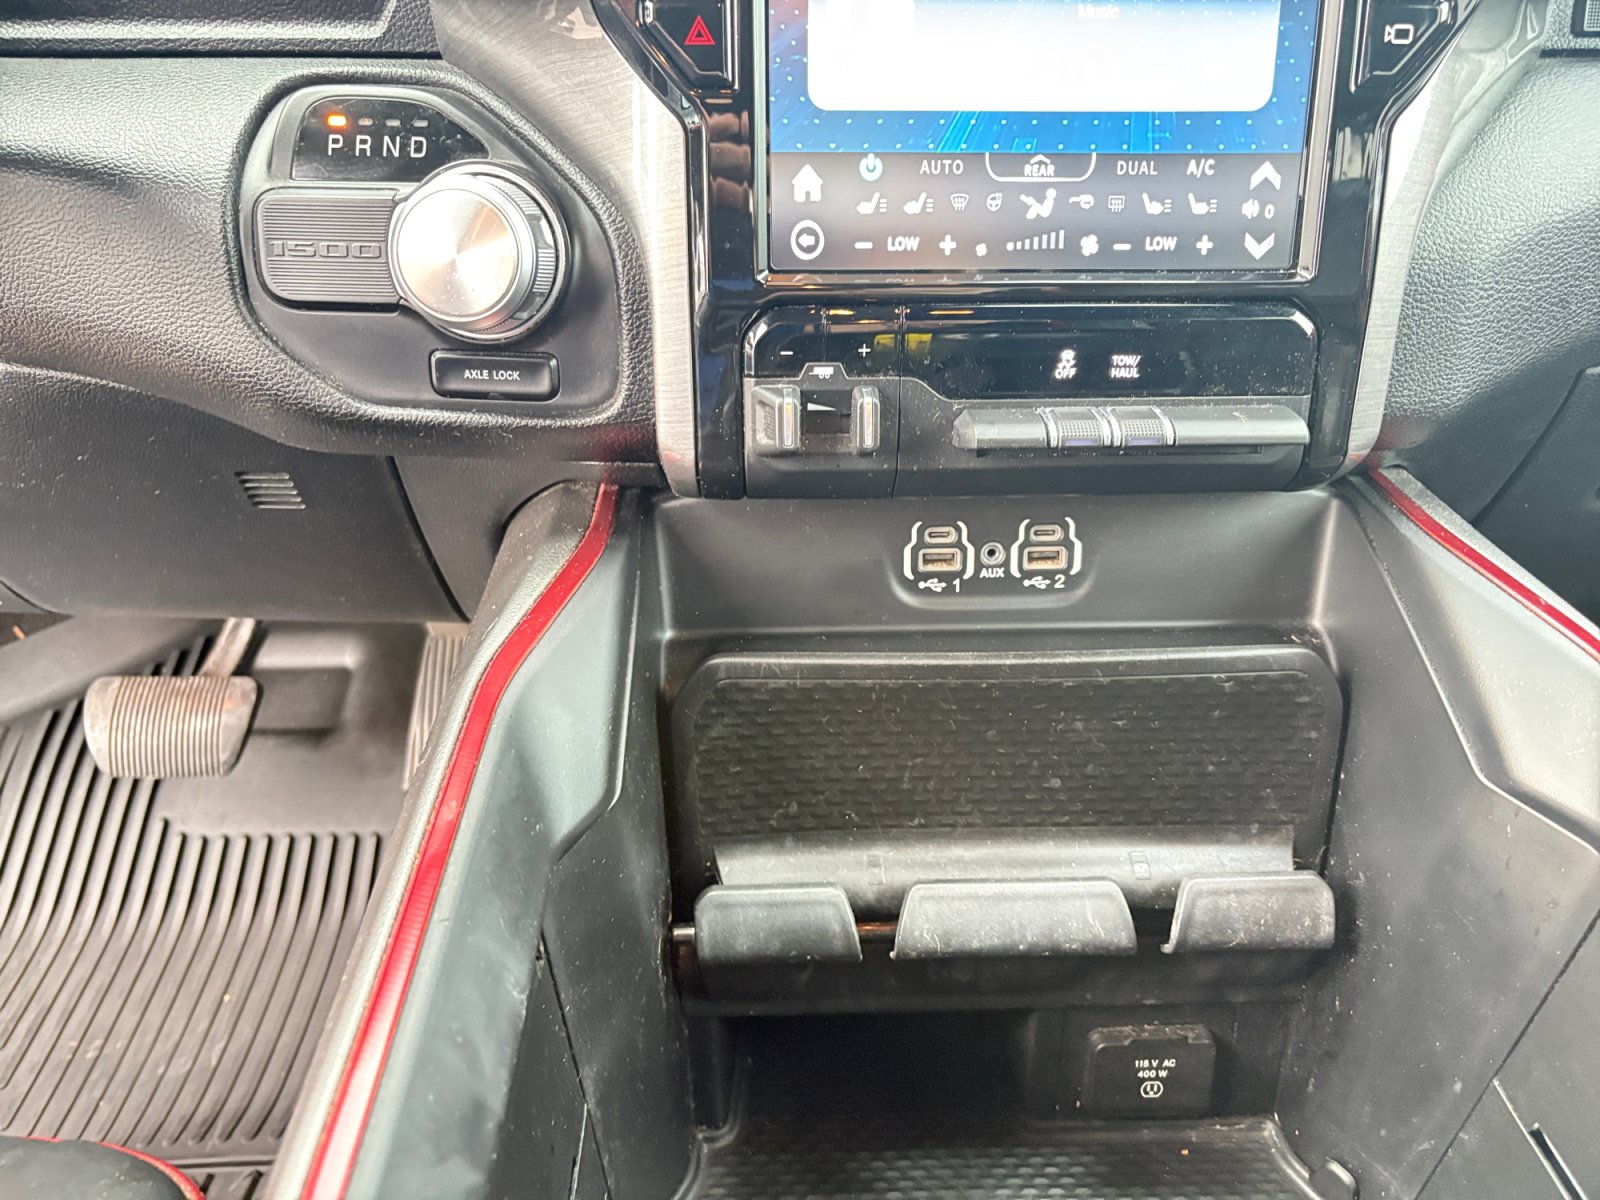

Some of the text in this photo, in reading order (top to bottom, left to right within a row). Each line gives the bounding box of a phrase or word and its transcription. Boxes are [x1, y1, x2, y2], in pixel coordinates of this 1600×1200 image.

[1077, 3, 1121, 21] Music
[919, 159, 964, 175] AUTO
[1023, 163, 1055, 177] REAR
[1116, 160, 1158, 176] DUAL
[1186, 158, 1216, 178] A/C
[1264, 203, 1275, 219] 0
[269, 240, 382, 259] 1500
[887, 235, 920, 251] LOW
[1145, 236, 1177, 251] LOW
[1111, 354, 1142, 366] TOW/
[463, 368, 521, 381] AXLE LOCK
[1054, 367, 1077, 379] OFF
[1110, 367, 1141, 379] HAUL
[979, 567, 1005, 579] AUX
[952, 578, 961, 593] 1
[1053, 574, 1066, 589] 2
[1135, 1058, 1176, 1068] 115 V AC
[1137, 1069, 1168, 1078] 400 W
